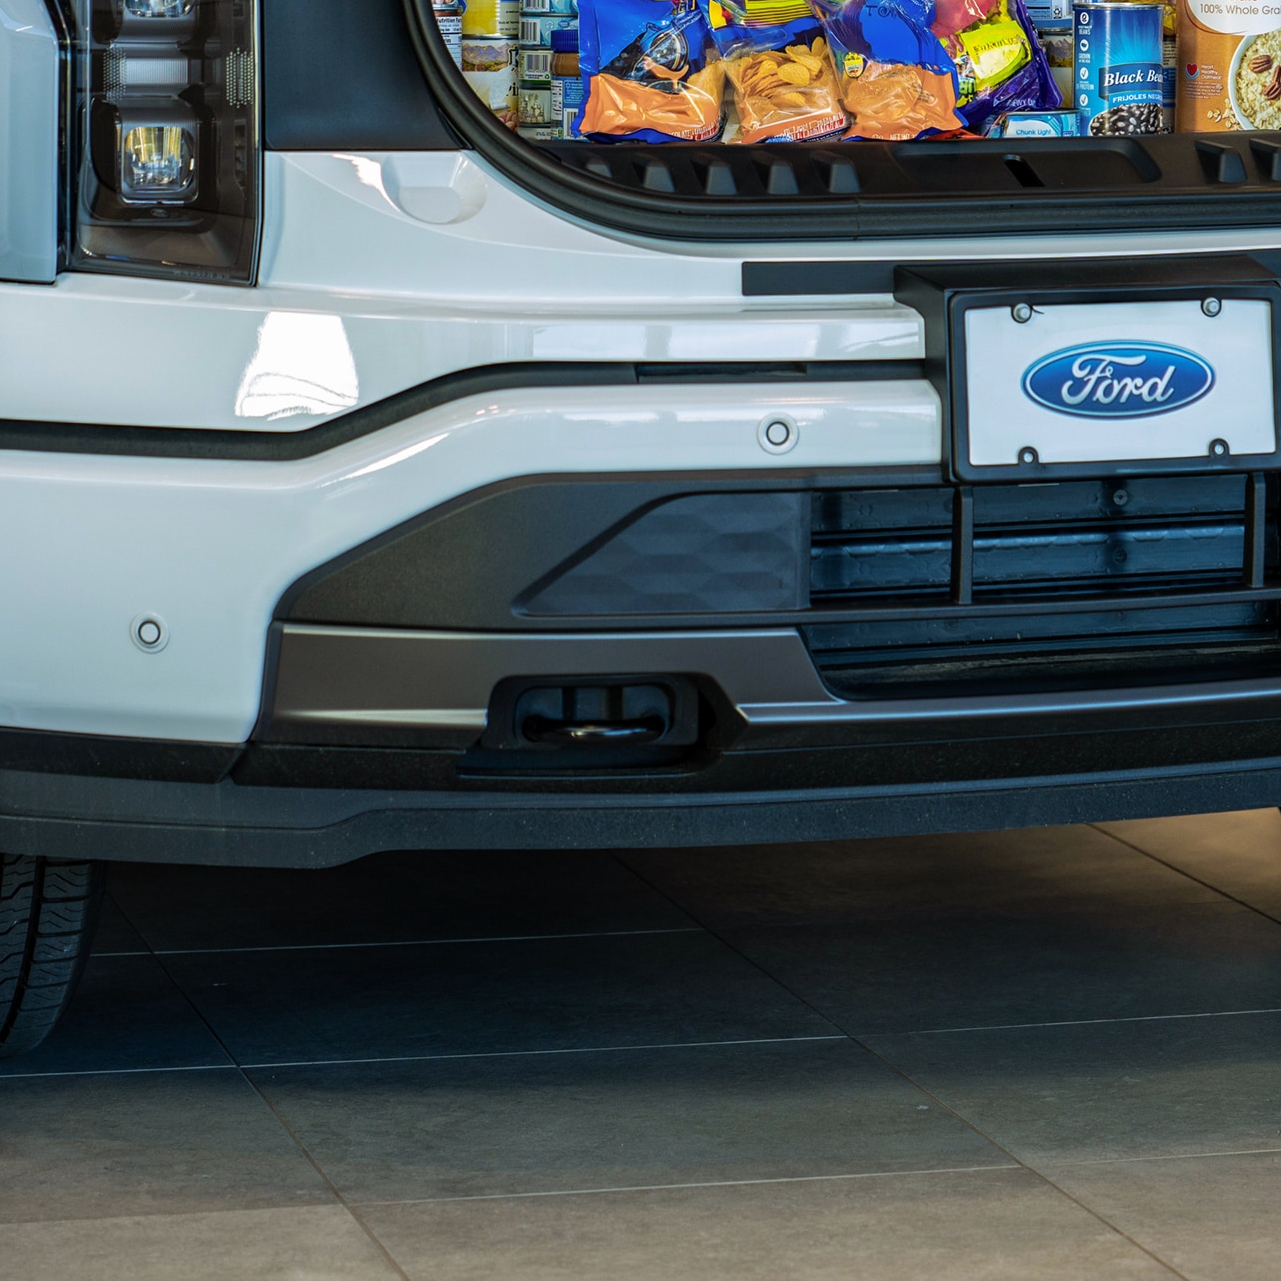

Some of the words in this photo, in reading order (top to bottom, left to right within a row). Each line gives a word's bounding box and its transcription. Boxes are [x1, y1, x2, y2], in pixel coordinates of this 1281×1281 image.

[1200, 4, 1223, 14] 100%
[1226, 5, 1259, 15] Whole
[1103, 70, 1143, 87] Black
[1113, 94, 1147, 103] FRIJOLES
[1016, 128, 1036, 136] Chunk
[1061, 354, 1176, 405] Ford
